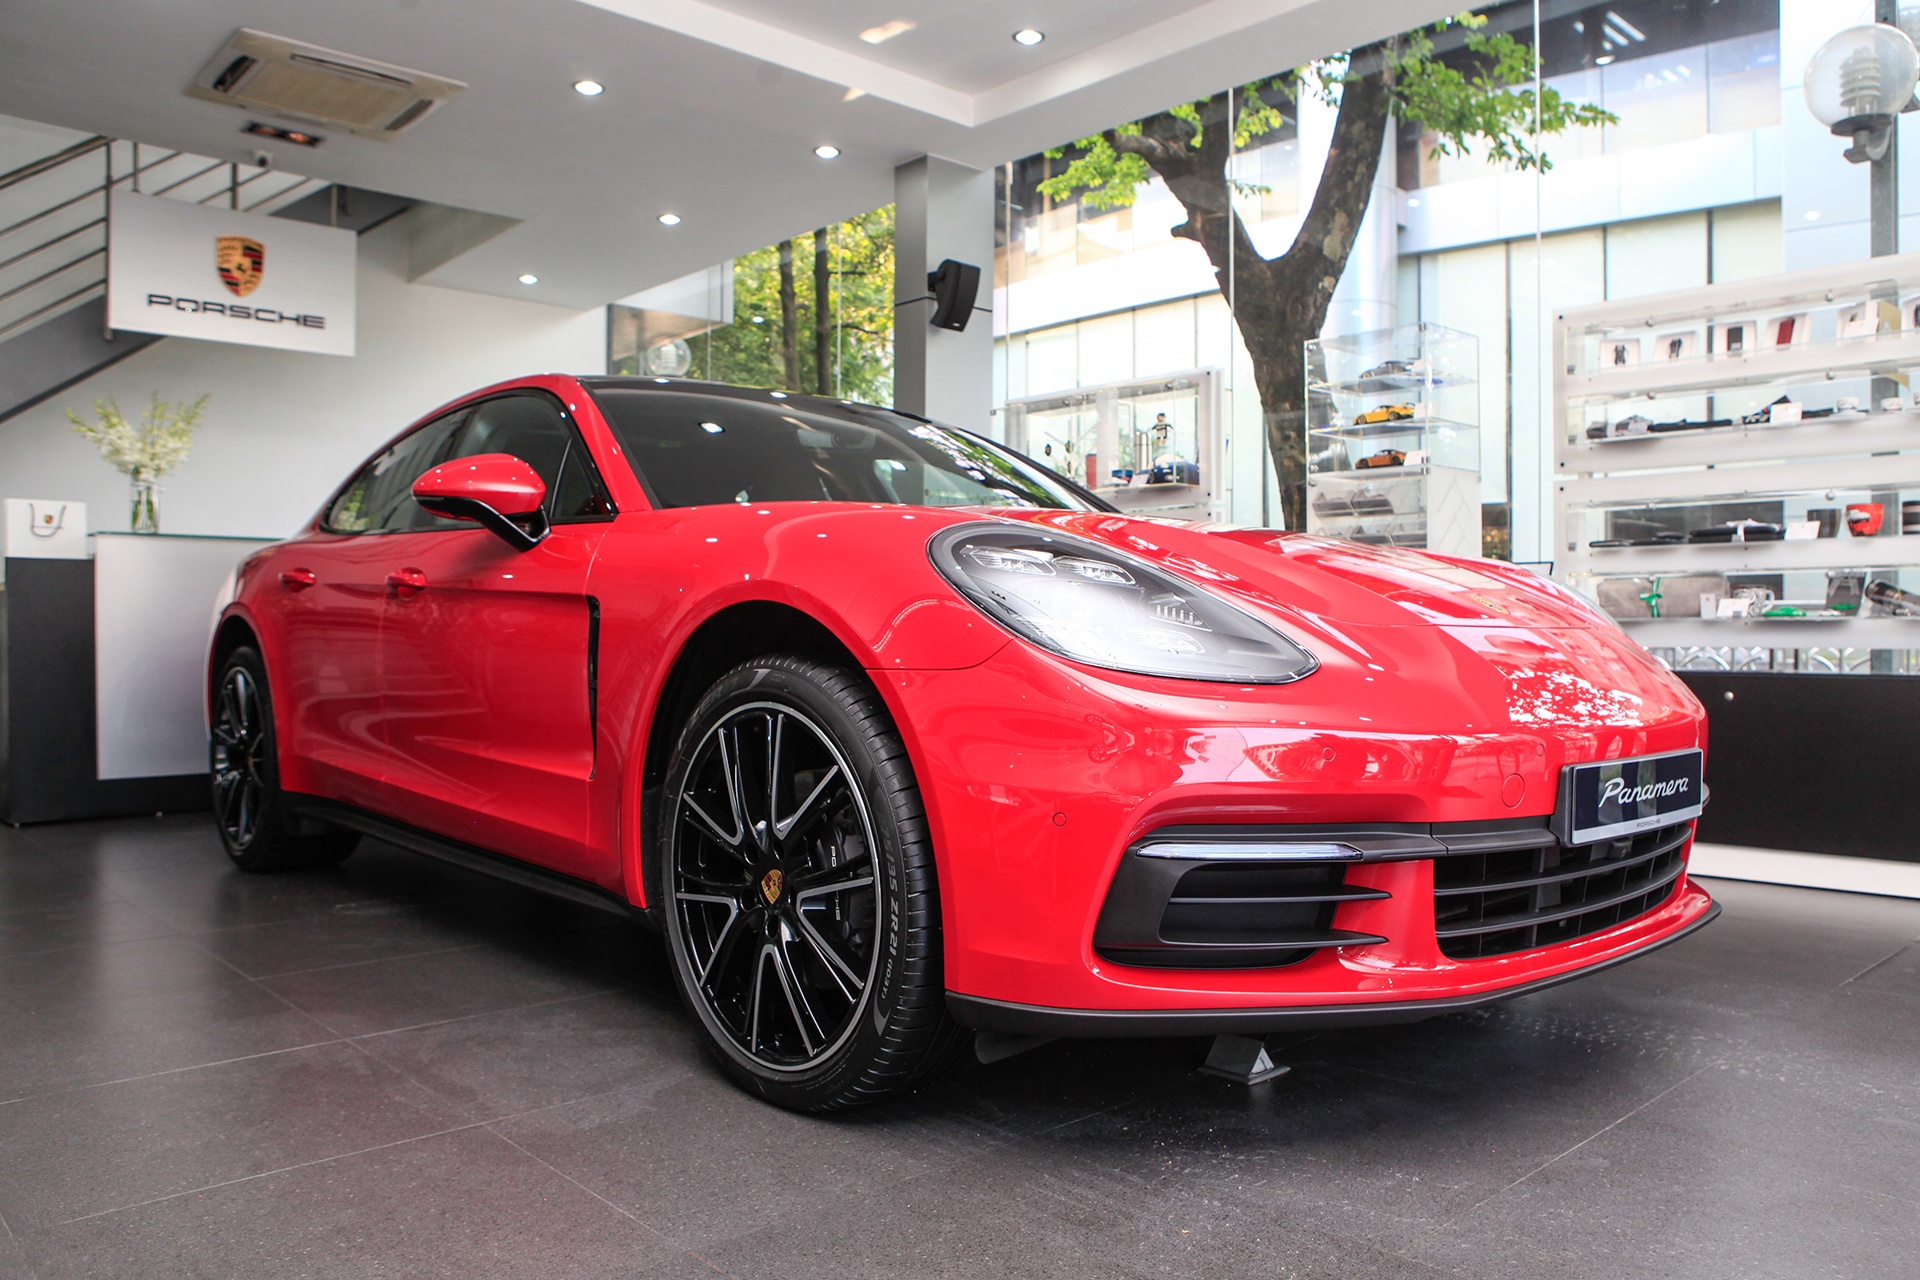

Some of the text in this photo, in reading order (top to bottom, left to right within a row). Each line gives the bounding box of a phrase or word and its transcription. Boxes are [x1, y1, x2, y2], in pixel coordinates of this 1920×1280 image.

[147, 293, 326, 329] PORSCHE
[1598, 777, 1689, 808] Panamera
[889, 897, 899, 956] ZR21
